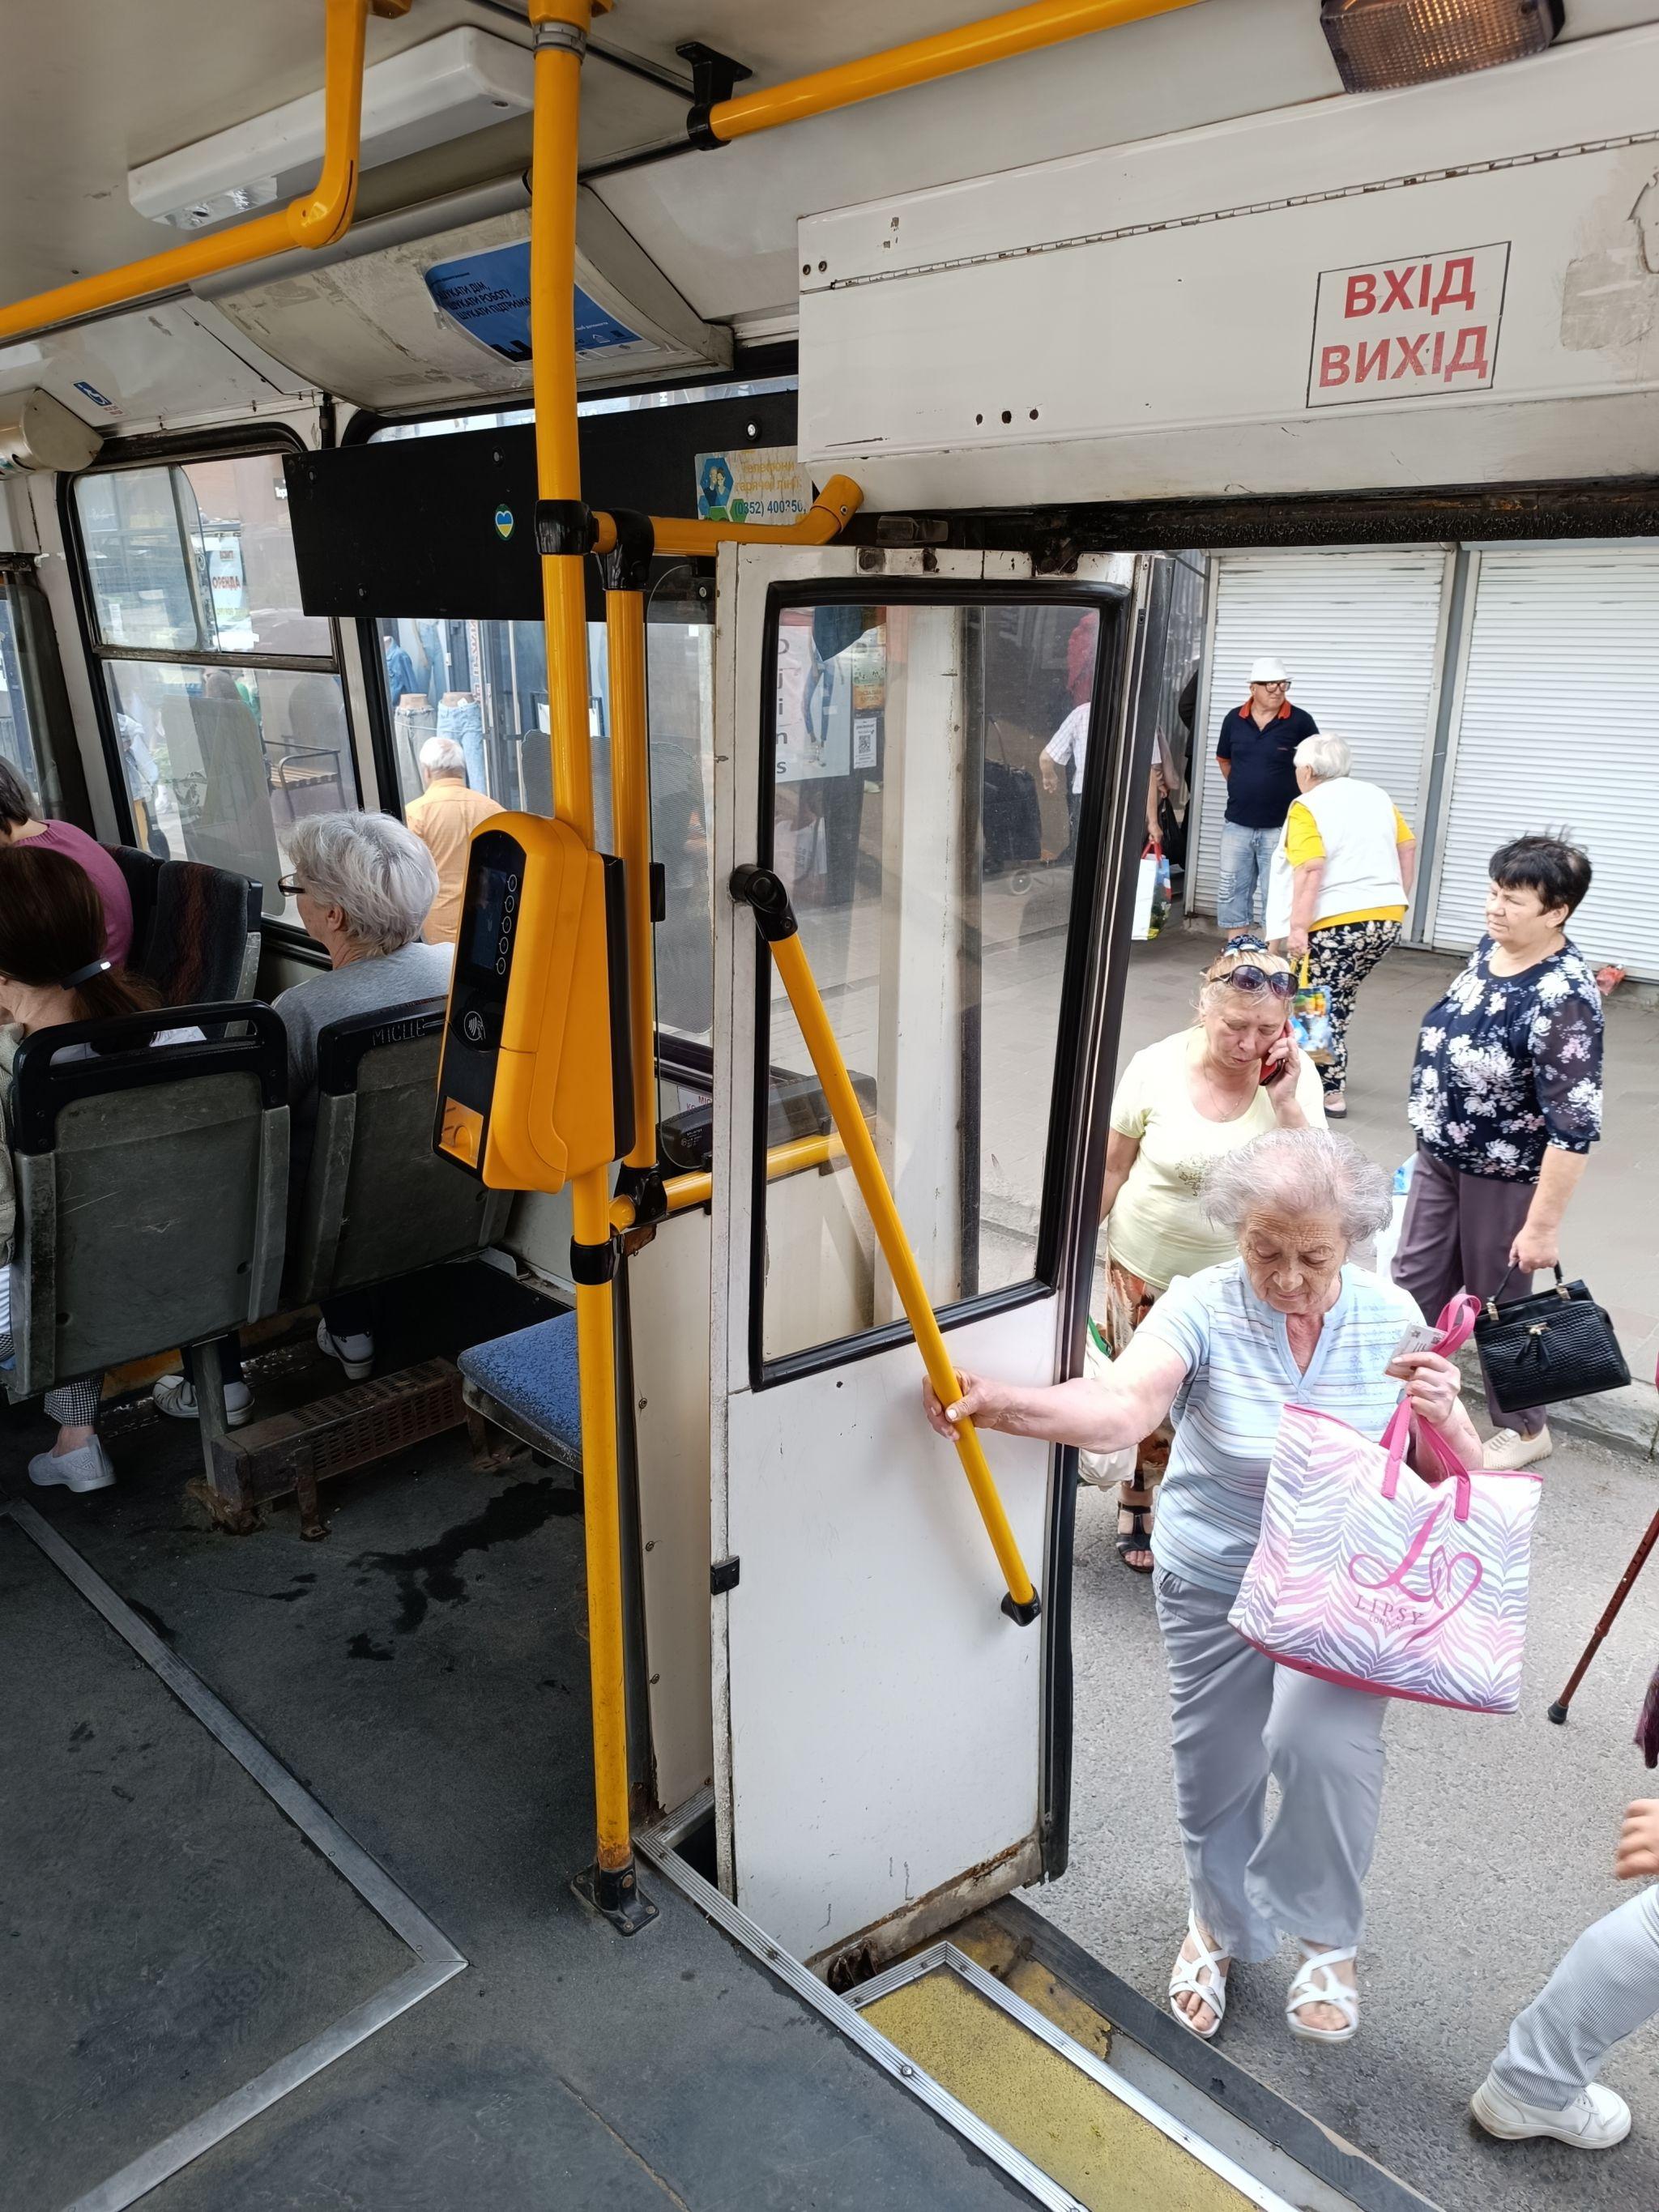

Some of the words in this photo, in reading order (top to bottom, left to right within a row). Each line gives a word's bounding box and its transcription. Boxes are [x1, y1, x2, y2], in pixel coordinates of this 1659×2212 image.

[1344, 256, 1477, 319] ВХІД
[448, 296, 481, 310] ШУКАТИ
[457, 306, 493, 320] ШУКАТИ
[1319, 325, 1488, 389] ВИХІД
[734, 500, 765, 517] (0352)
[1354, 1594, 1425, 1626] LIPSY
[1368, 1614, 1402, 1630] LONDON
